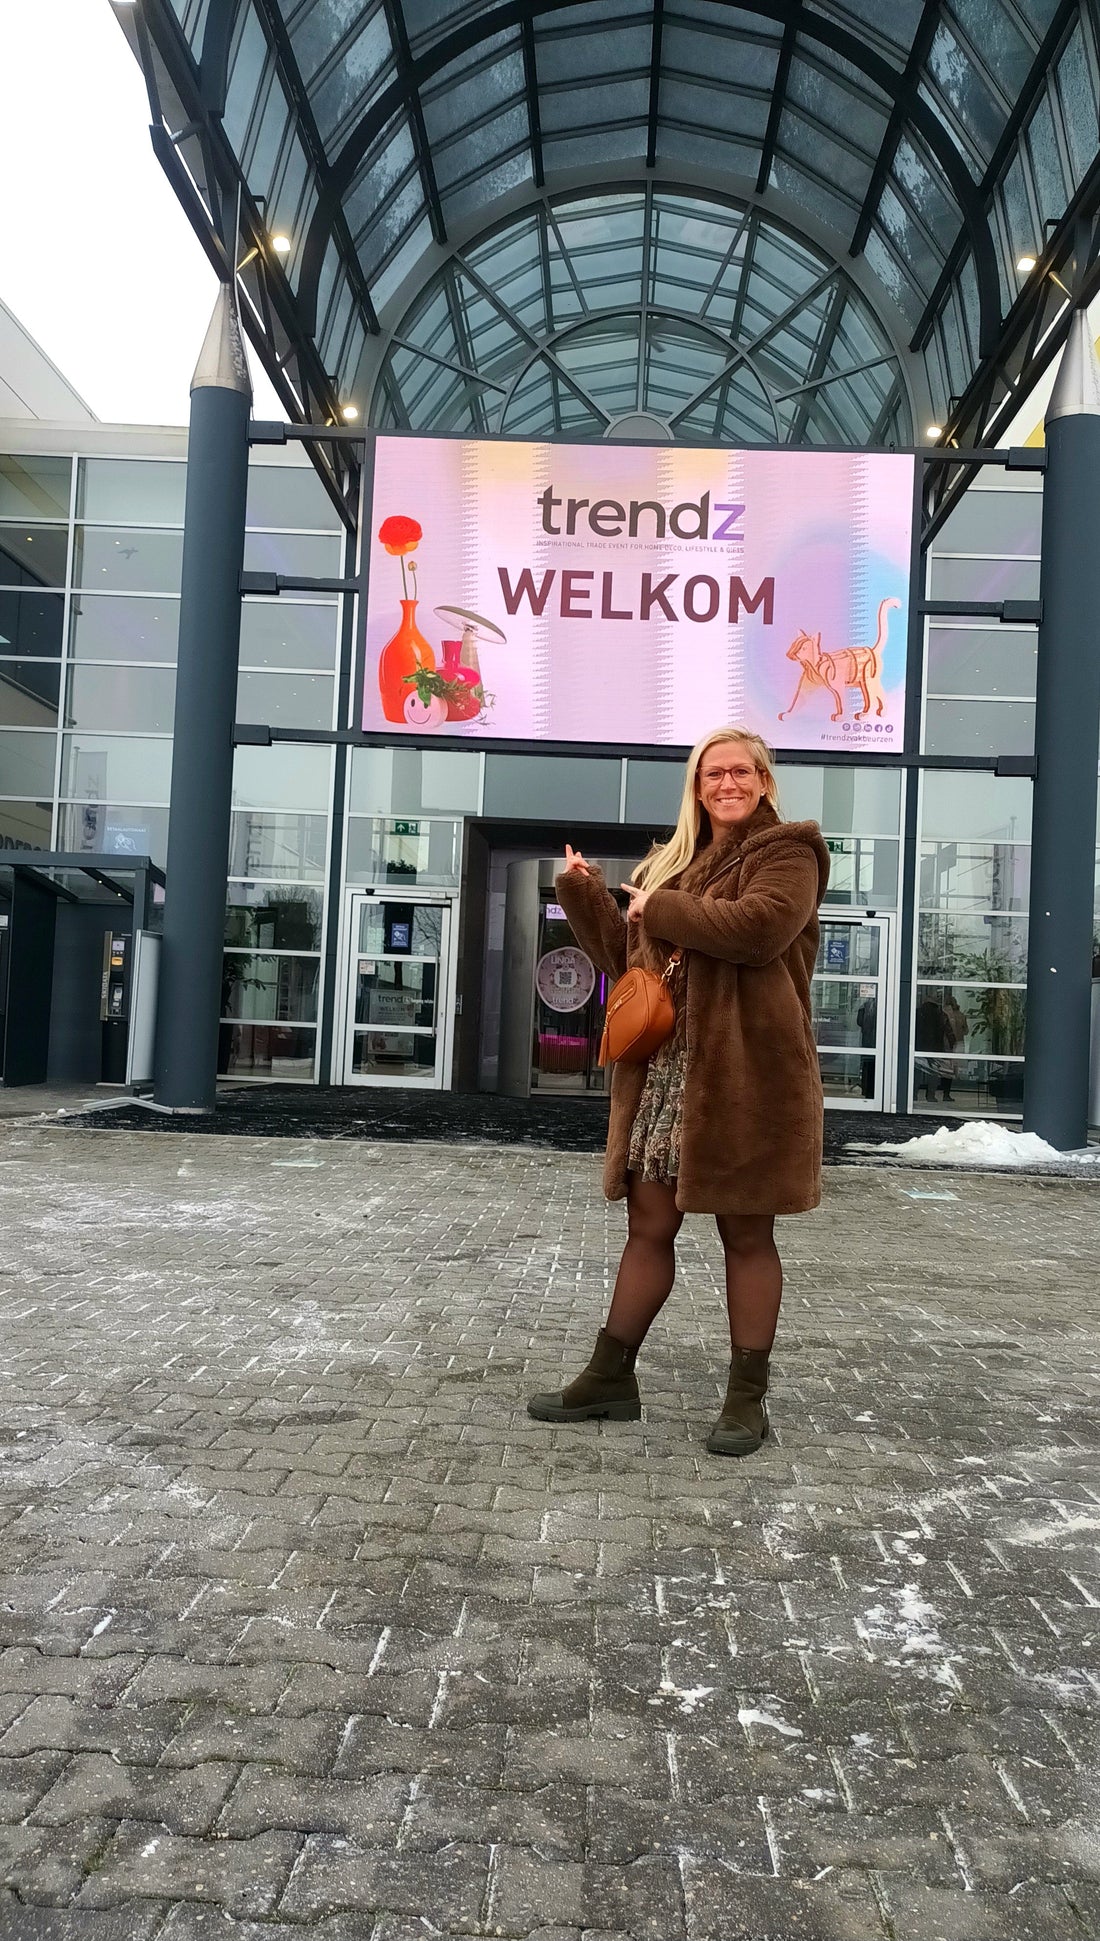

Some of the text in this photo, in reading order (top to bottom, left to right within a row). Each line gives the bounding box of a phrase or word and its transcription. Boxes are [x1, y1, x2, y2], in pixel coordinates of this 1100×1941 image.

[537, 485, 746, 541] trendz
[535, 540, 584, 548] INSPIRATIONAL
[685, 545, 717, 553] LIFESTYLE
[497, 567, 775, 625] WELKOM
